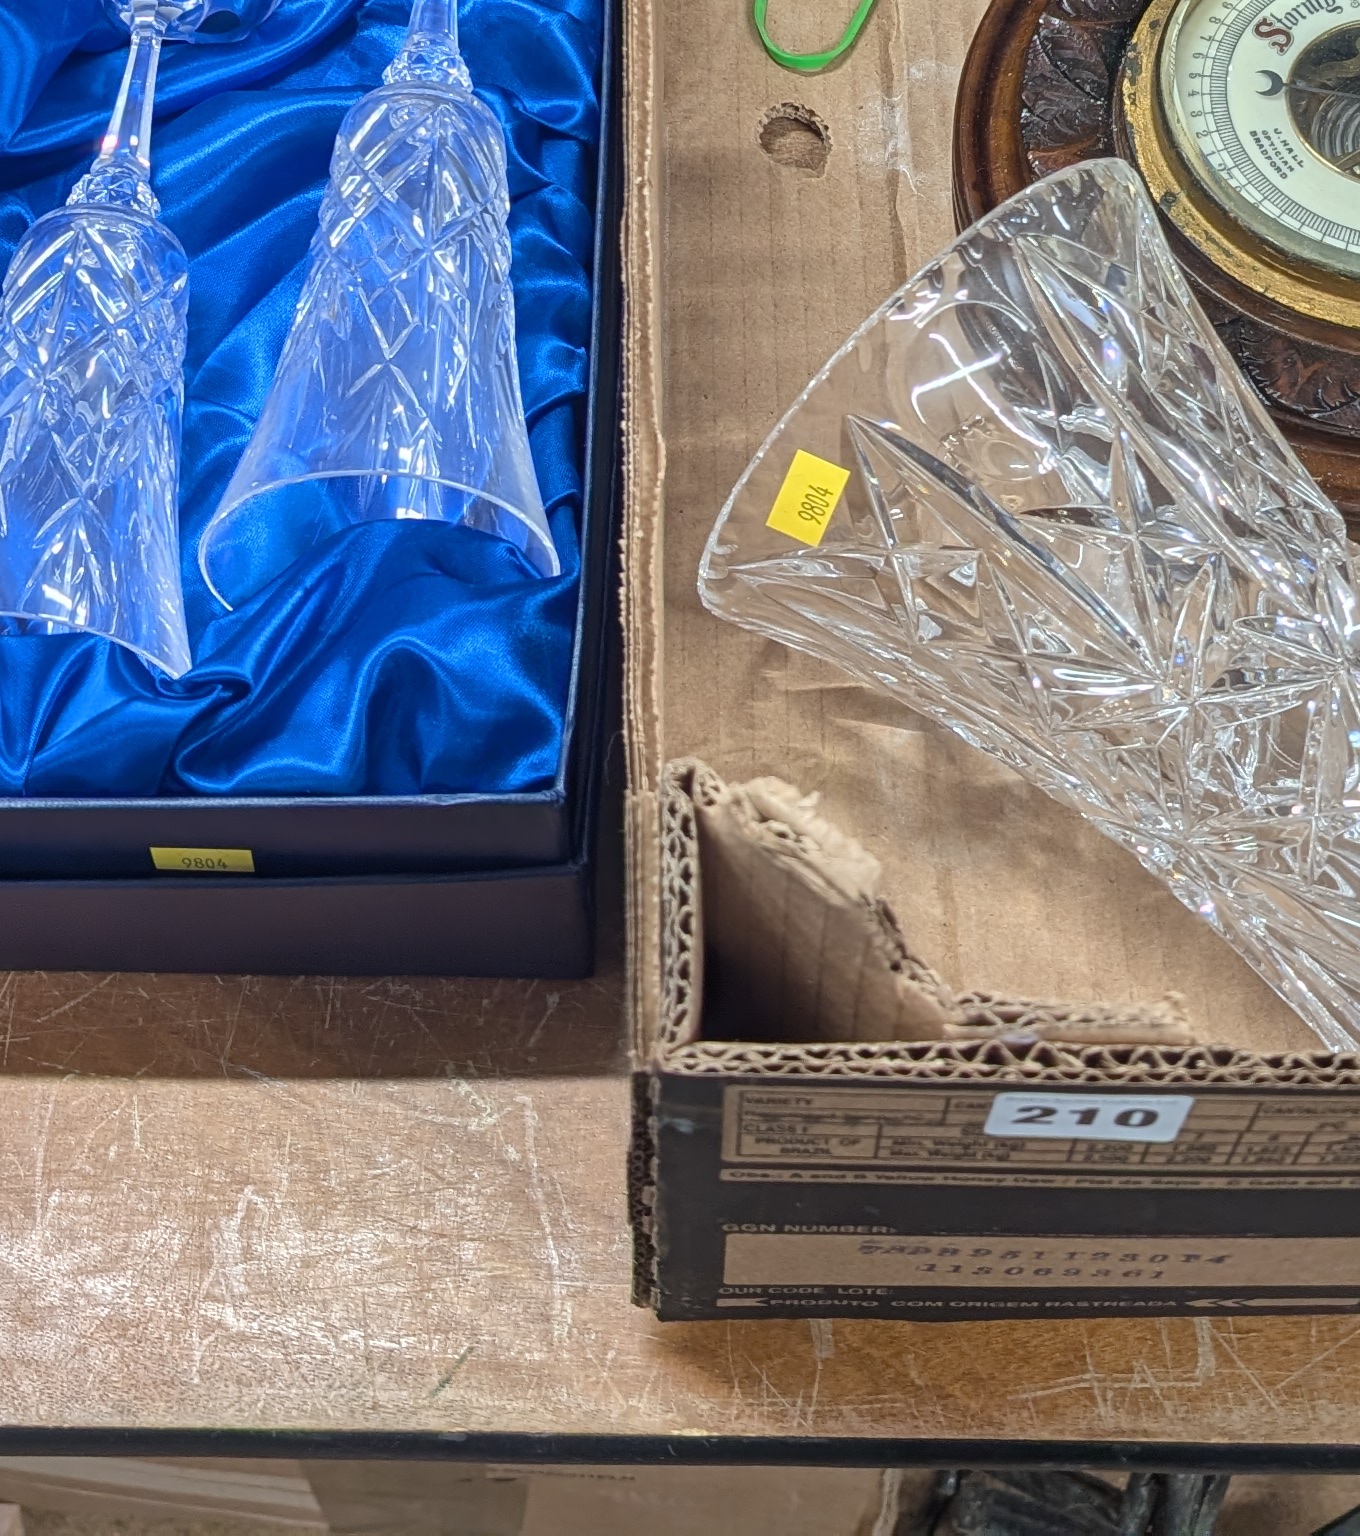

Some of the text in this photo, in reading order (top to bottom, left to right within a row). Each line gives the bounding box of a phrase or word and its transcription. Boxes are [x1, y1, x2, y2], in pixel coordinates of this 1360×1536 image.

[1249, 130, 1288, 180] BRADFORD
[1261, 129, 1295, 172] OPTICIAN
[797, 484, 834, 526] 9804
[181, 857, 228, 870] 9804
[1010, 1105, 1159, 1127] 210
